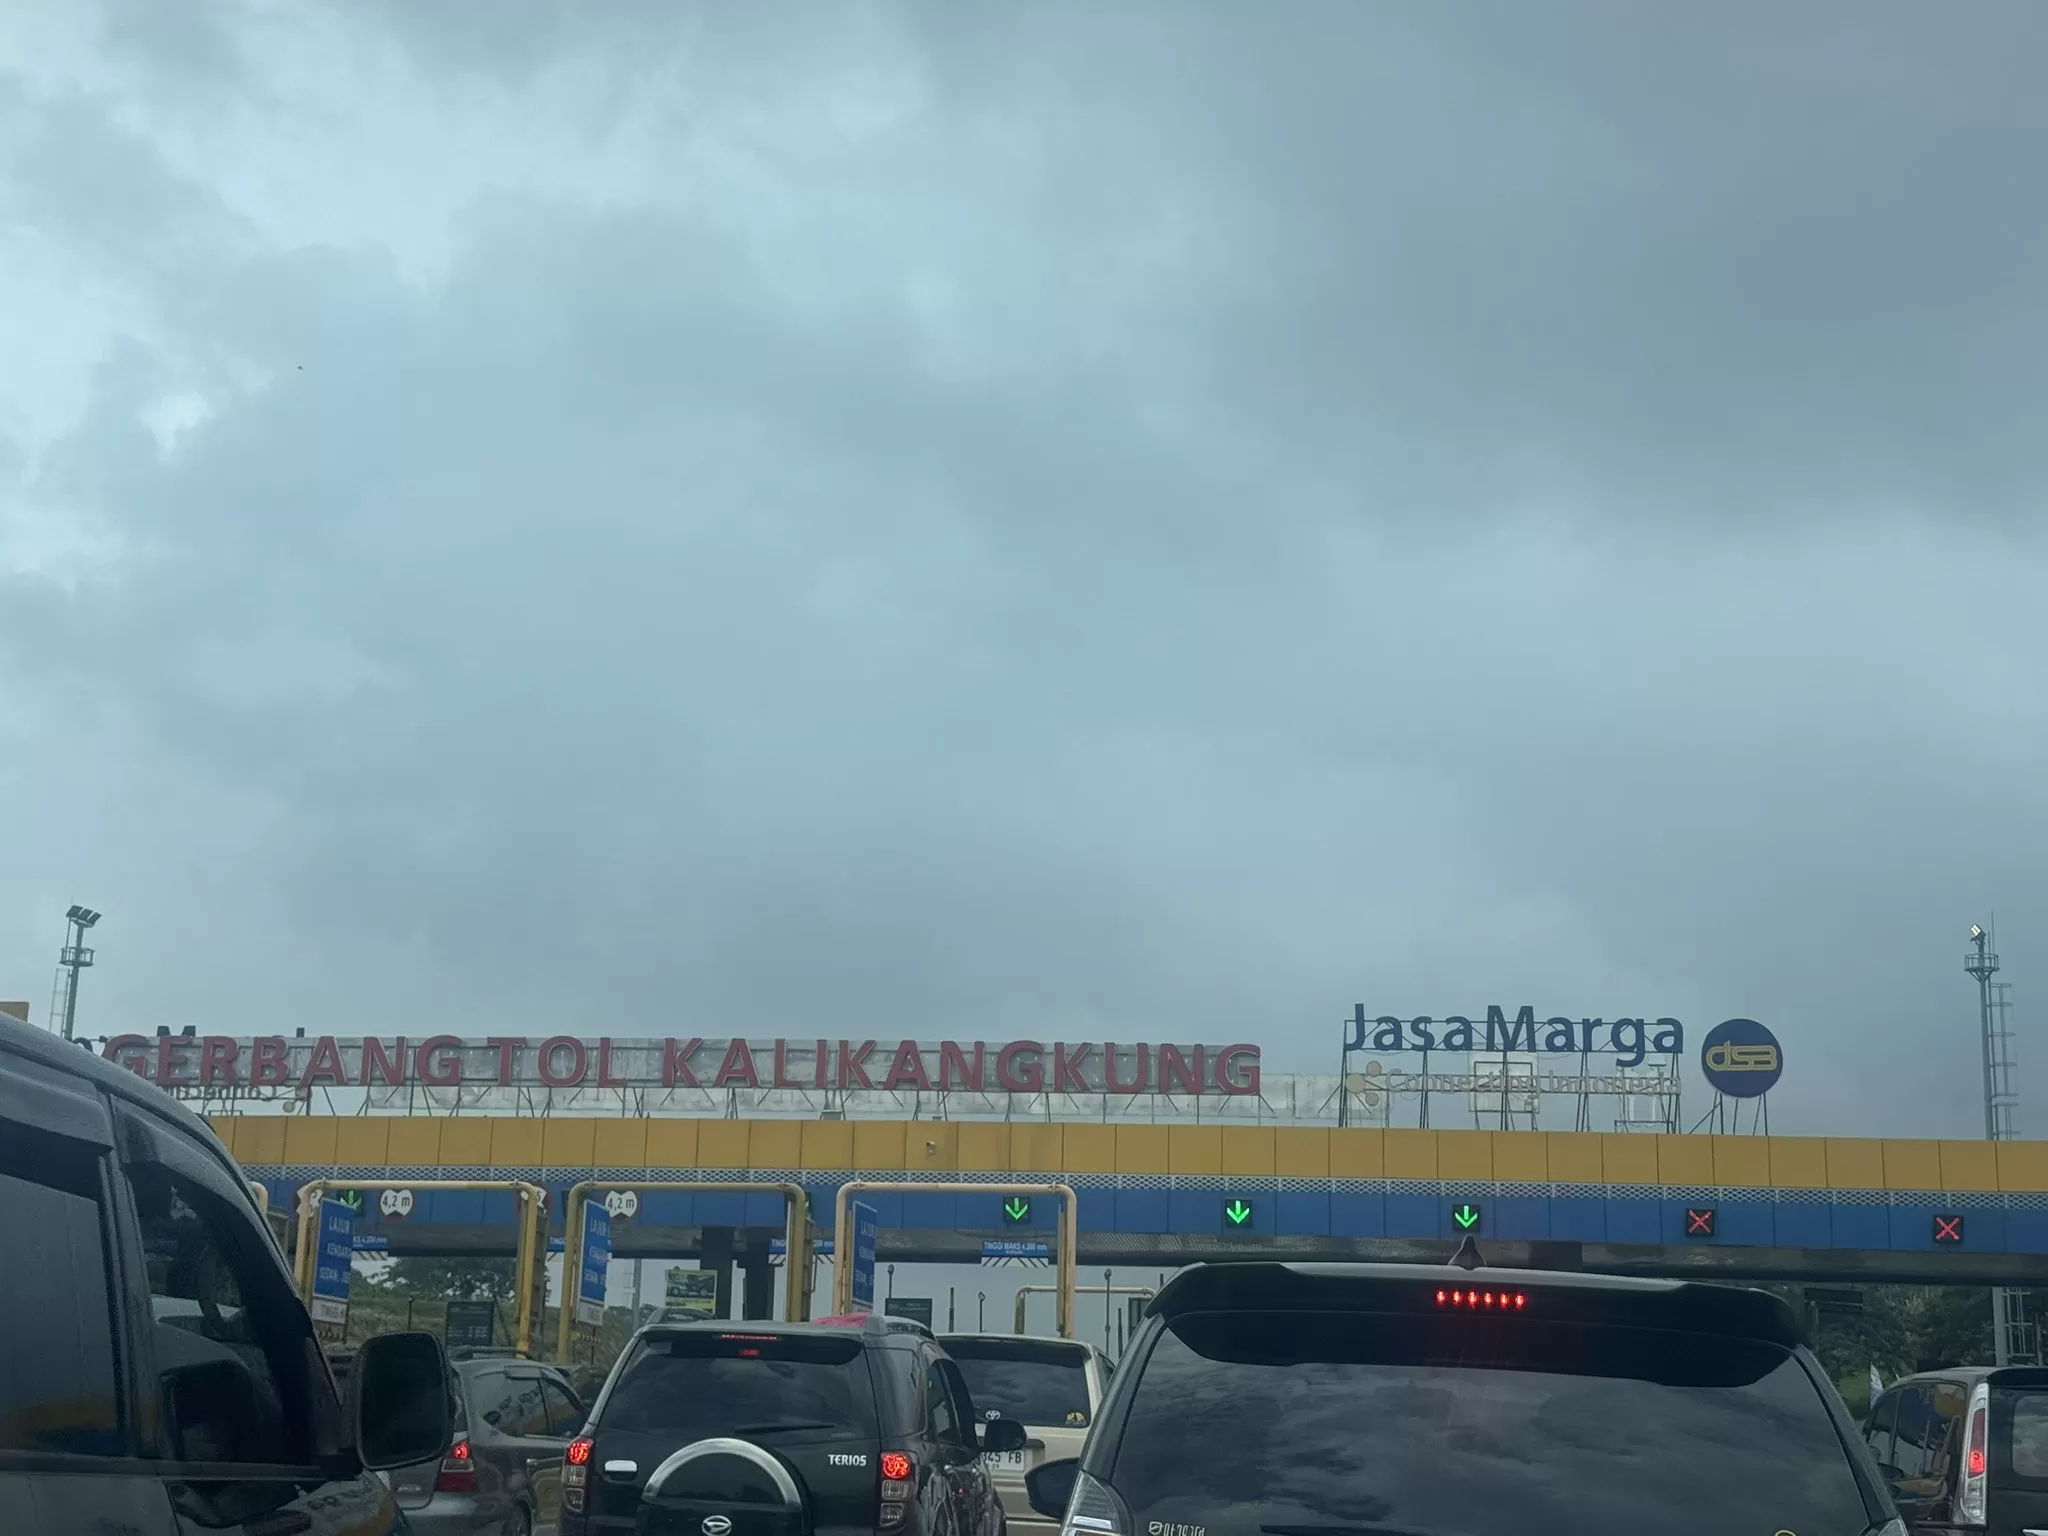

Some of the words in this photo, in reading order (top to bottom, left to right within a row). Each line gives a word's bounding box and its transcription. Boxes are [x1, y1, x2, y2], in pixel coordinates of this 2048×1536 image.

[1345, 1003, 1684, 1066] JasaMarga
[101, 1034, 462, 1087] GERBANG
[487, 1035, 629, 1087] TOL
[662, 1037, 1261, 1096] KALIKANGKUNG
[1386, 1069, 1541, 1099] Connecting
[1549, 1069, 1682, 1096] Indonesia
[401, 1196, 411, 1207] m
[828, 1454, 867, 1466] TERIOS
[1008, 1451, 1022, 1464] FB
